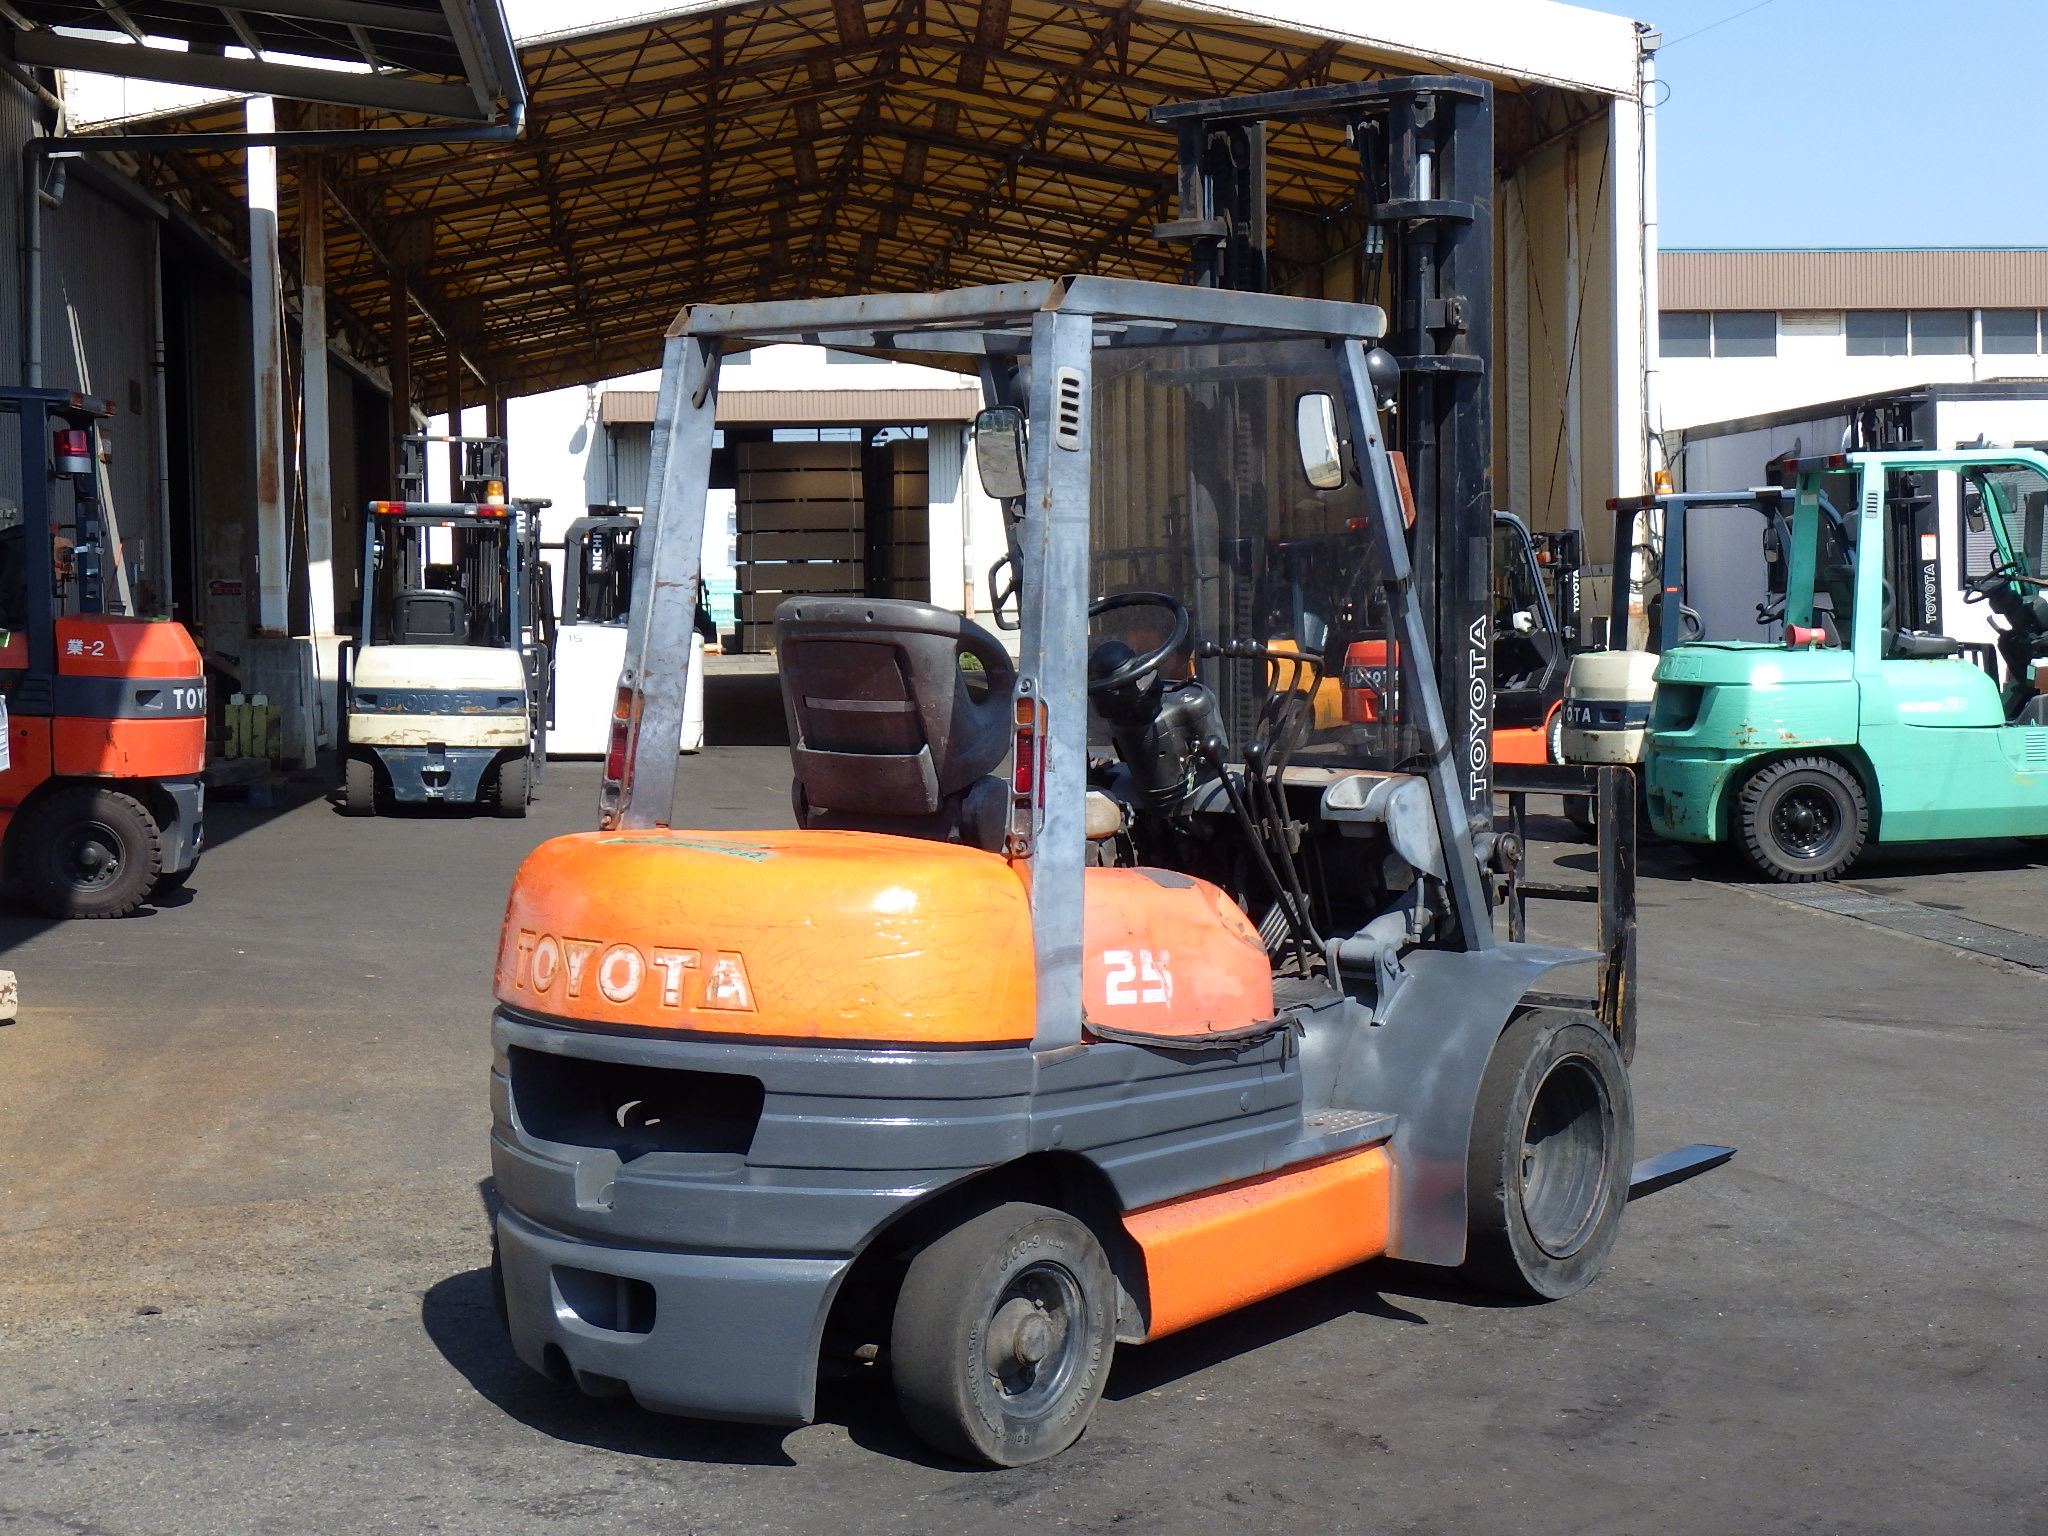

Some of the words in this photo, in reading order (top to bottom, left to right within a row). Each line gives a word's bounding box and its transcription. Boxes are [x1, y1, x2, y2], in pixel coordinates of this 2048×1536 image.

[1572, 569, 1580, 613] TOYOTA
[1924, 563, 1937, 624] TOYOTA
[66, 638, 105, 657] 業-2
[172, 686, 207, 711] TOY
[1469, 614, 1487, 801] TOYOTA
[513, 928, 760, 1013] TOYOTA
[1000, 1234, 1042, 1273] 6.00-9
